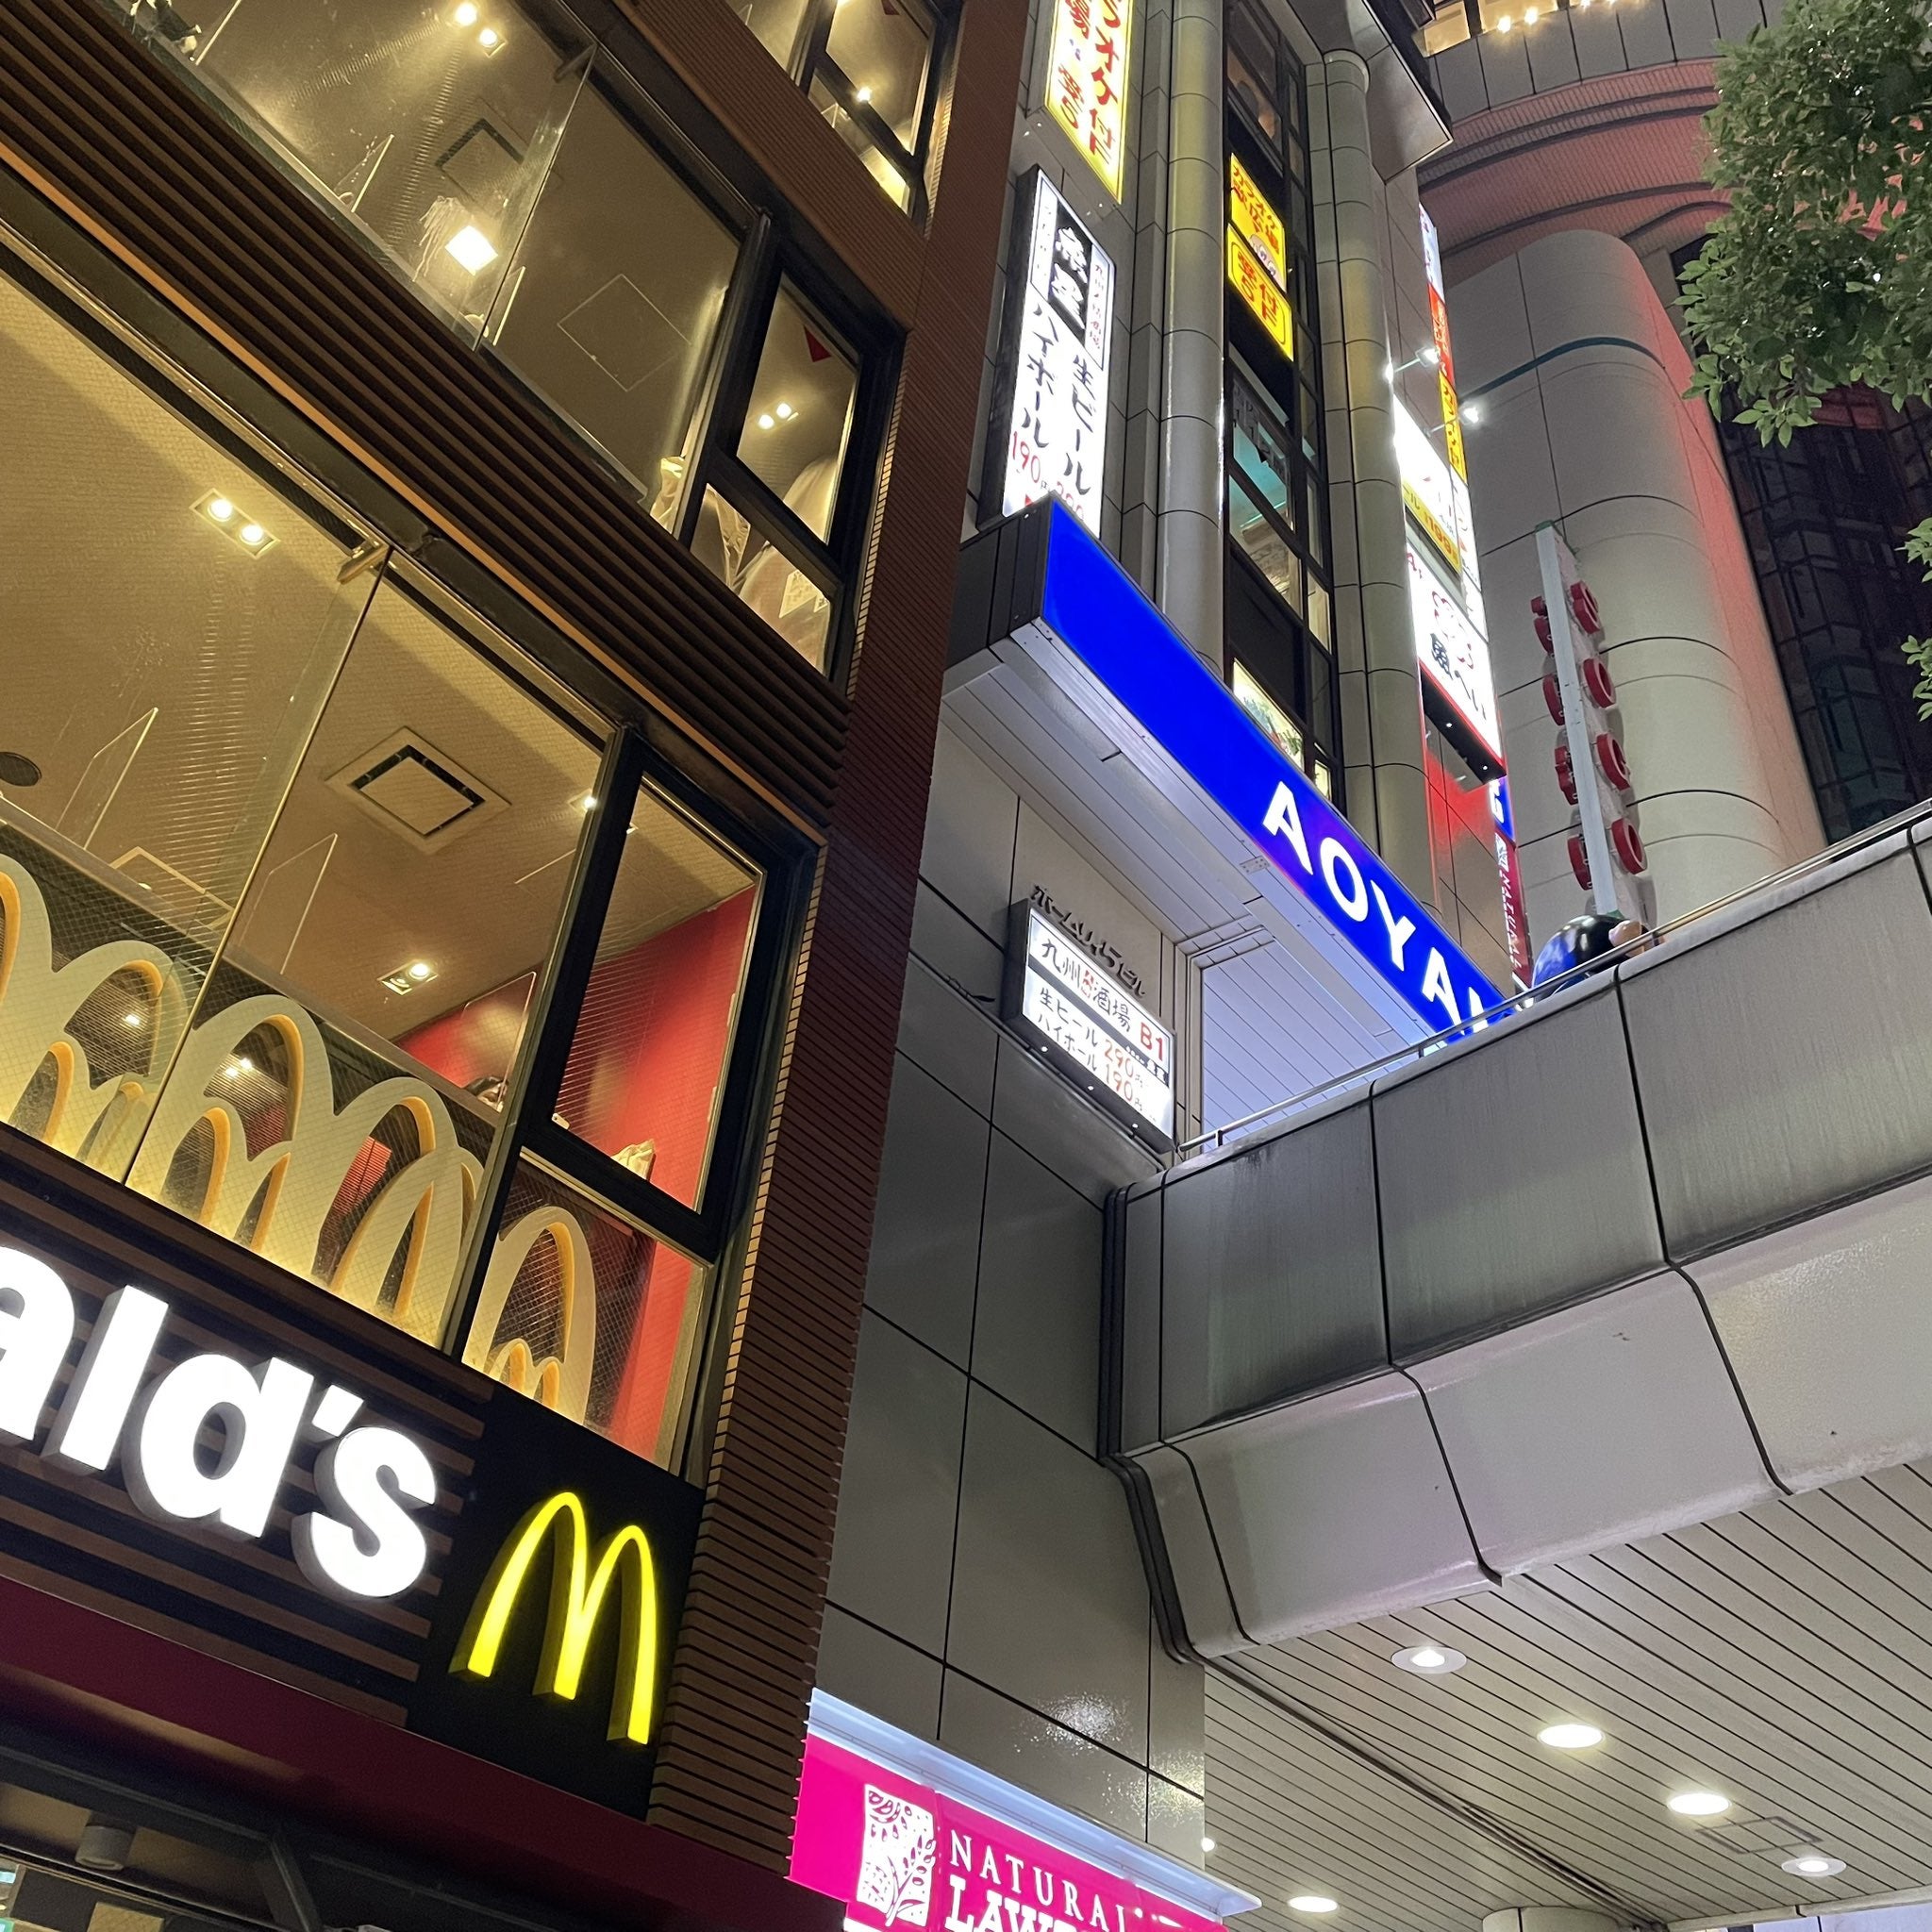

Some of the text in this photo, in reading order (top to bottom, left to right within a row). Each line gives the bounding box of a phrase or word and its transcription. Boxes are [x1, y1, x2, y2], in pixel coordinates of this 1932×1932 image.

[1020, 302, 1060, 449] ハイボール
[1071, 353, 1097, 496] 生ビール
[1140, 1022, 1164, 1062] B1
[944, 1874, 1078, 1932] LAW
